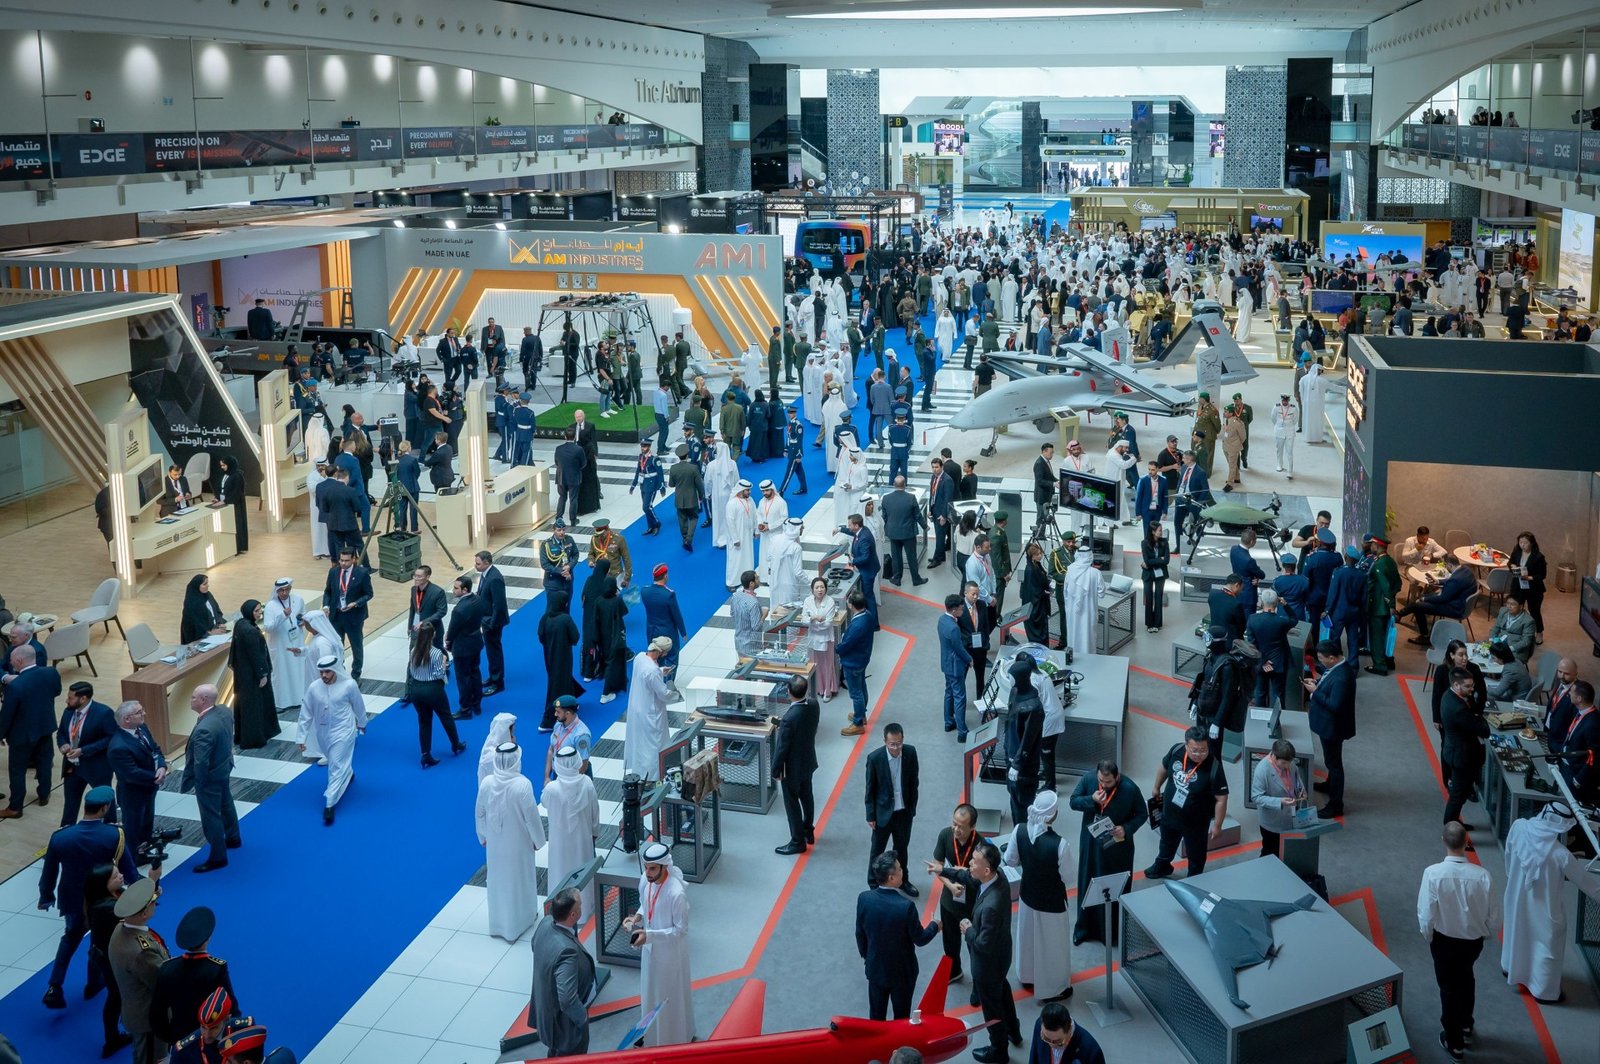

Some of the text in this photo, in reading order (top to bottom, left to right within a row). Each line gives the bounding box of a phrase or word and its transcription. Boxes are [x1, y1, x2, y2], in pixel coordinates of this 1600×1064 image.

[634, 79, 701, 103] The Atrium
[895, 117, 902, 126] B
[409, 131, 439, 139] PRECISION
[155, 137, 220, 147] PRECISION ON
[410, 141, 427, 149] EVERY
[80, 149, 126, 163] EDGE
[156, 150, 185, 160] EVERY
[1554, 144, 1571, 158] EDGE
[15, 157, 42, 170] جميع
[544, 253, 644, 267] AM INDUSTRIES
[694, 241, 767, 271] AMI
[277, 299, 323, 308] INDURIES
[170, 423, 231, 437] تمكين شركات
[170, 436, 231, 448] الدفاع الوطني
